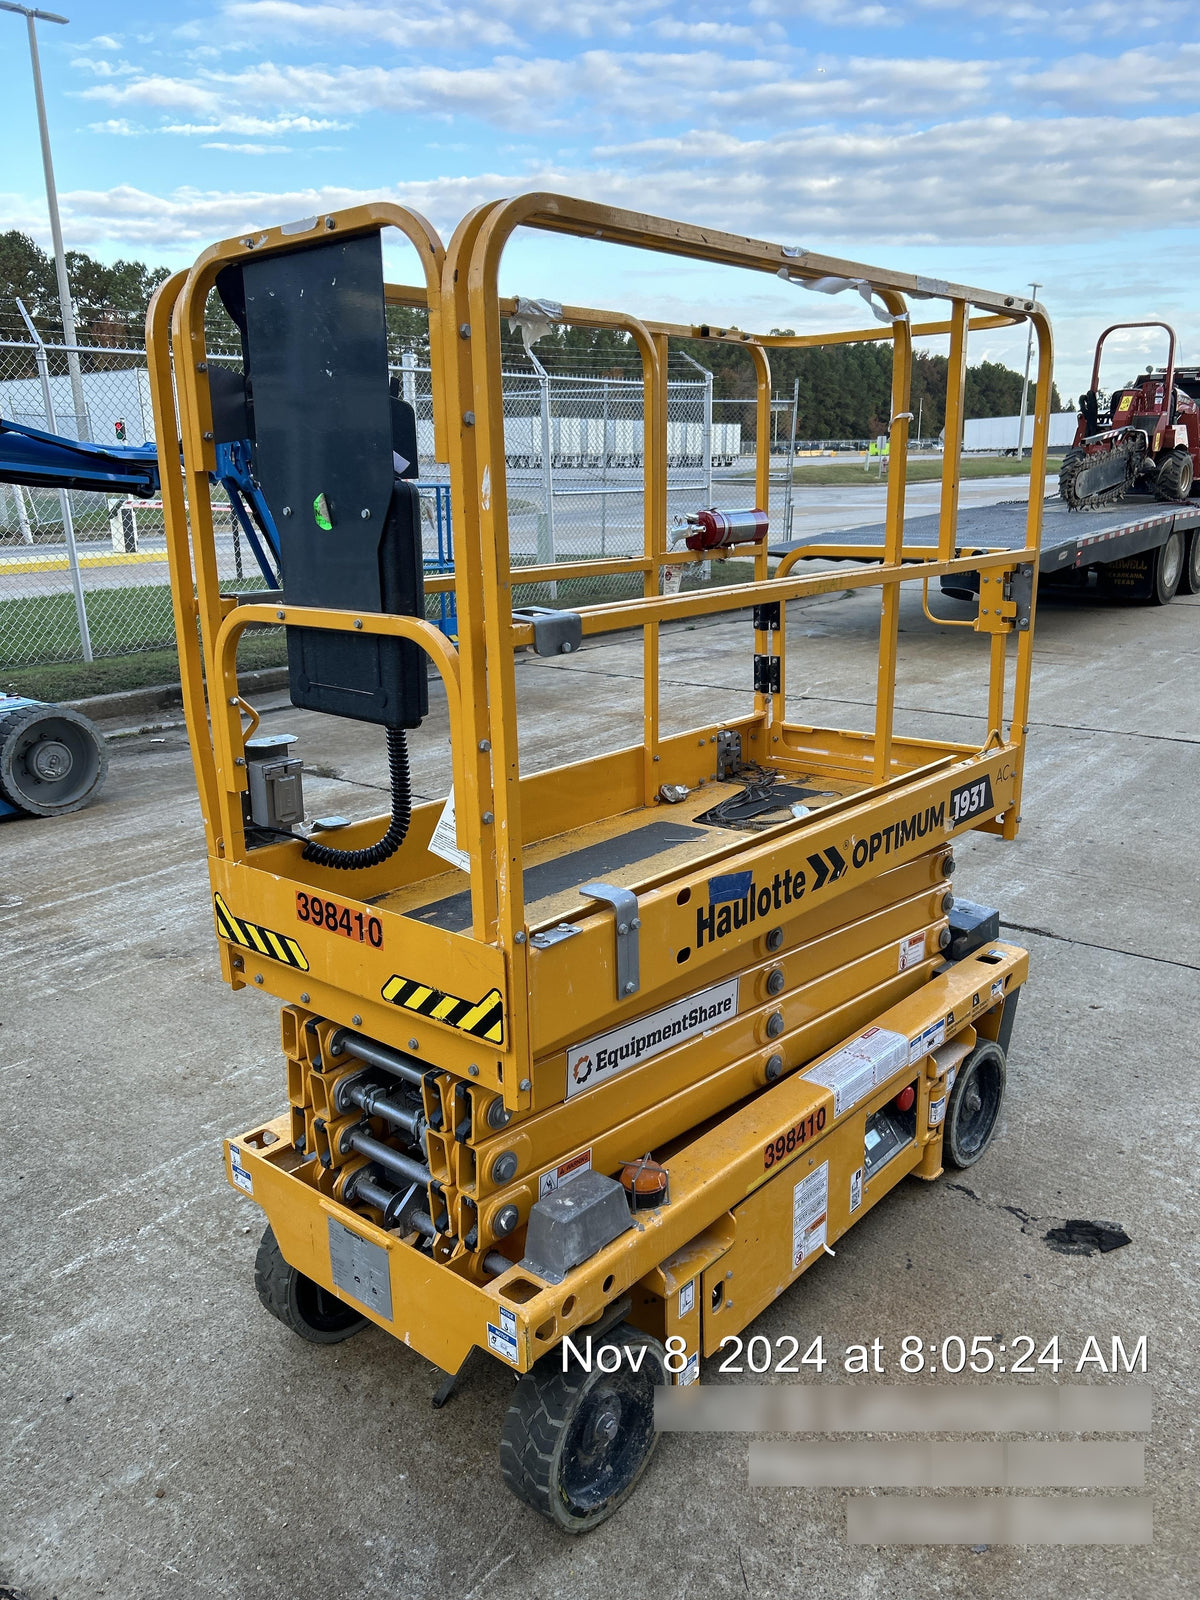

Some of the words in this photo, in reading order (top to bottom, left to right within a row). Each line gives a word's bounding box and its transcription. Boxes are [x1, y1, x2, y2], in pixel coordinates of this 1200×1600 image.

[697, 869, 806, 948] Haulotte
[852, 801, 946, 869] OPTIMUM
[953, 782, 986, 820] 1931
[996, 764, 1010, 784] AC
[297, 892, 383, 947] 398410
[595, 996, 732, 1072] EquipmentShare
[764, 1107, 826, 1169] 398410
